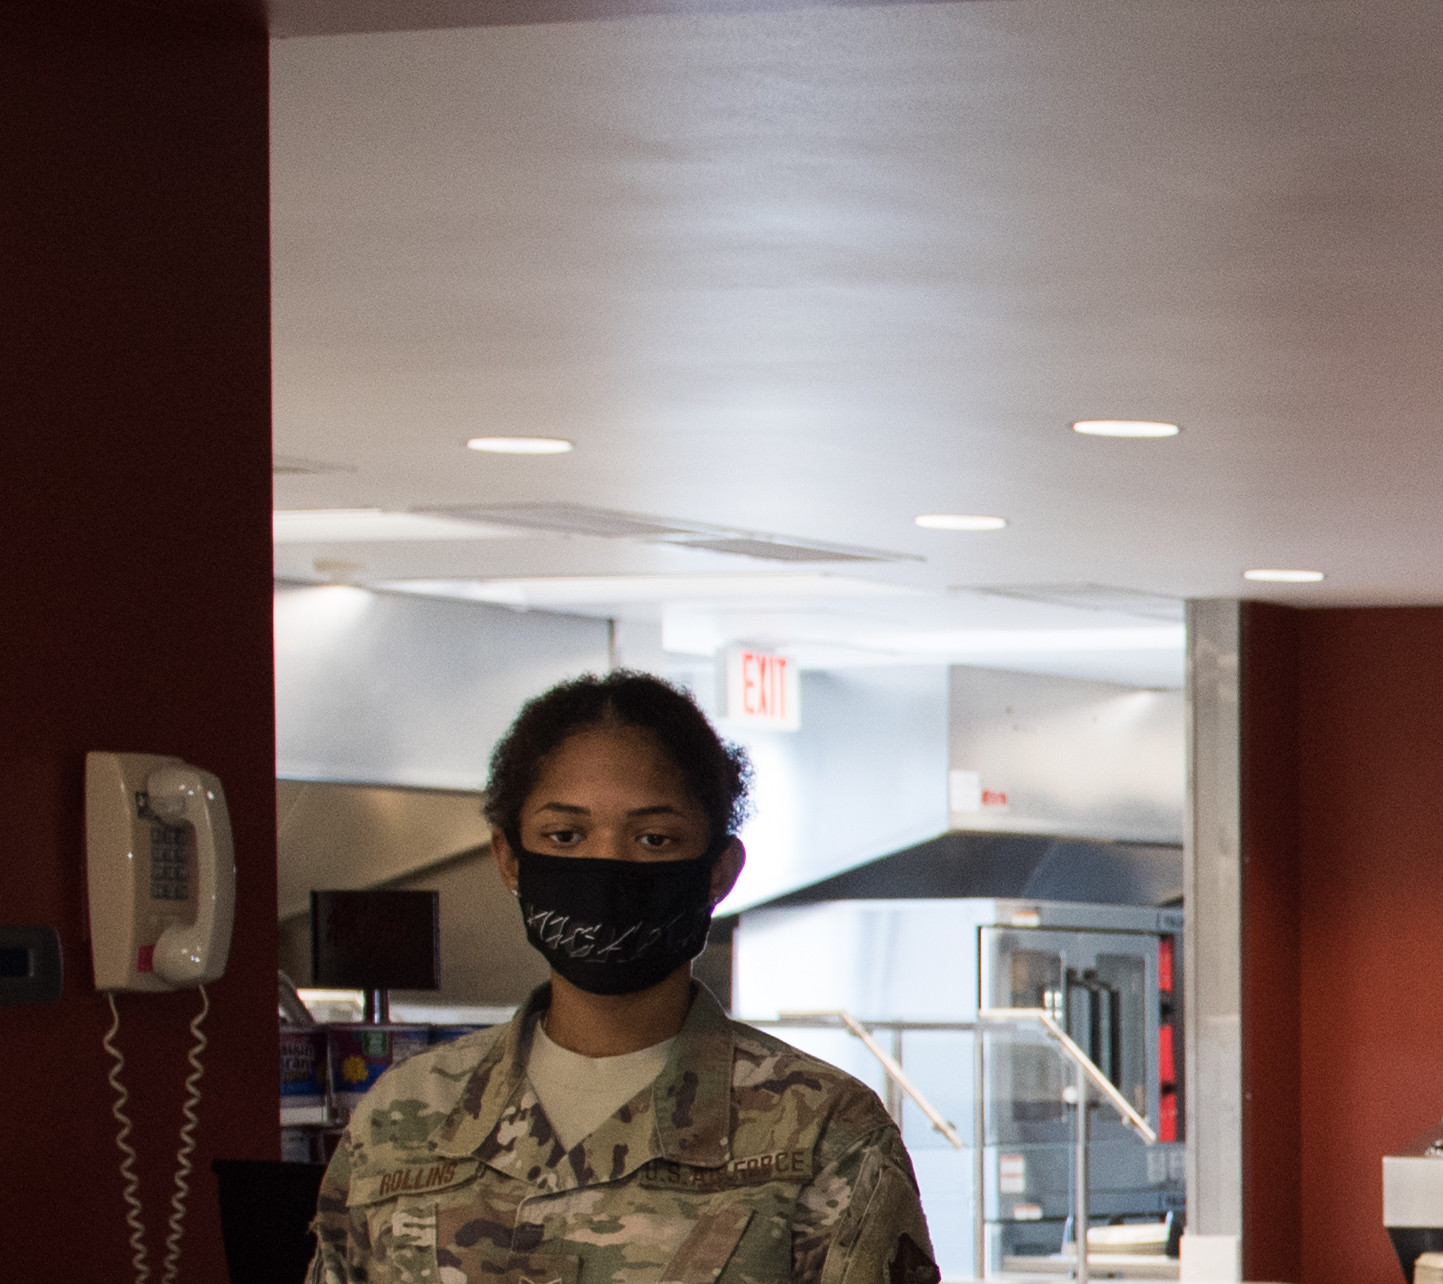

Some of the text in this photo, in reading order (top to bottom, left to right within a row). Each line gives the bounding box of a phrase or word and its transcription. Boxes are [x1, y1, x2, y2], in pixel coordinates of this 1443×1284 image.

[742, 651, 787, 717] EXIT
[380, 1161, 457, 1195] ROLLINS
[732, 1151, 804, 1181] FORCE
